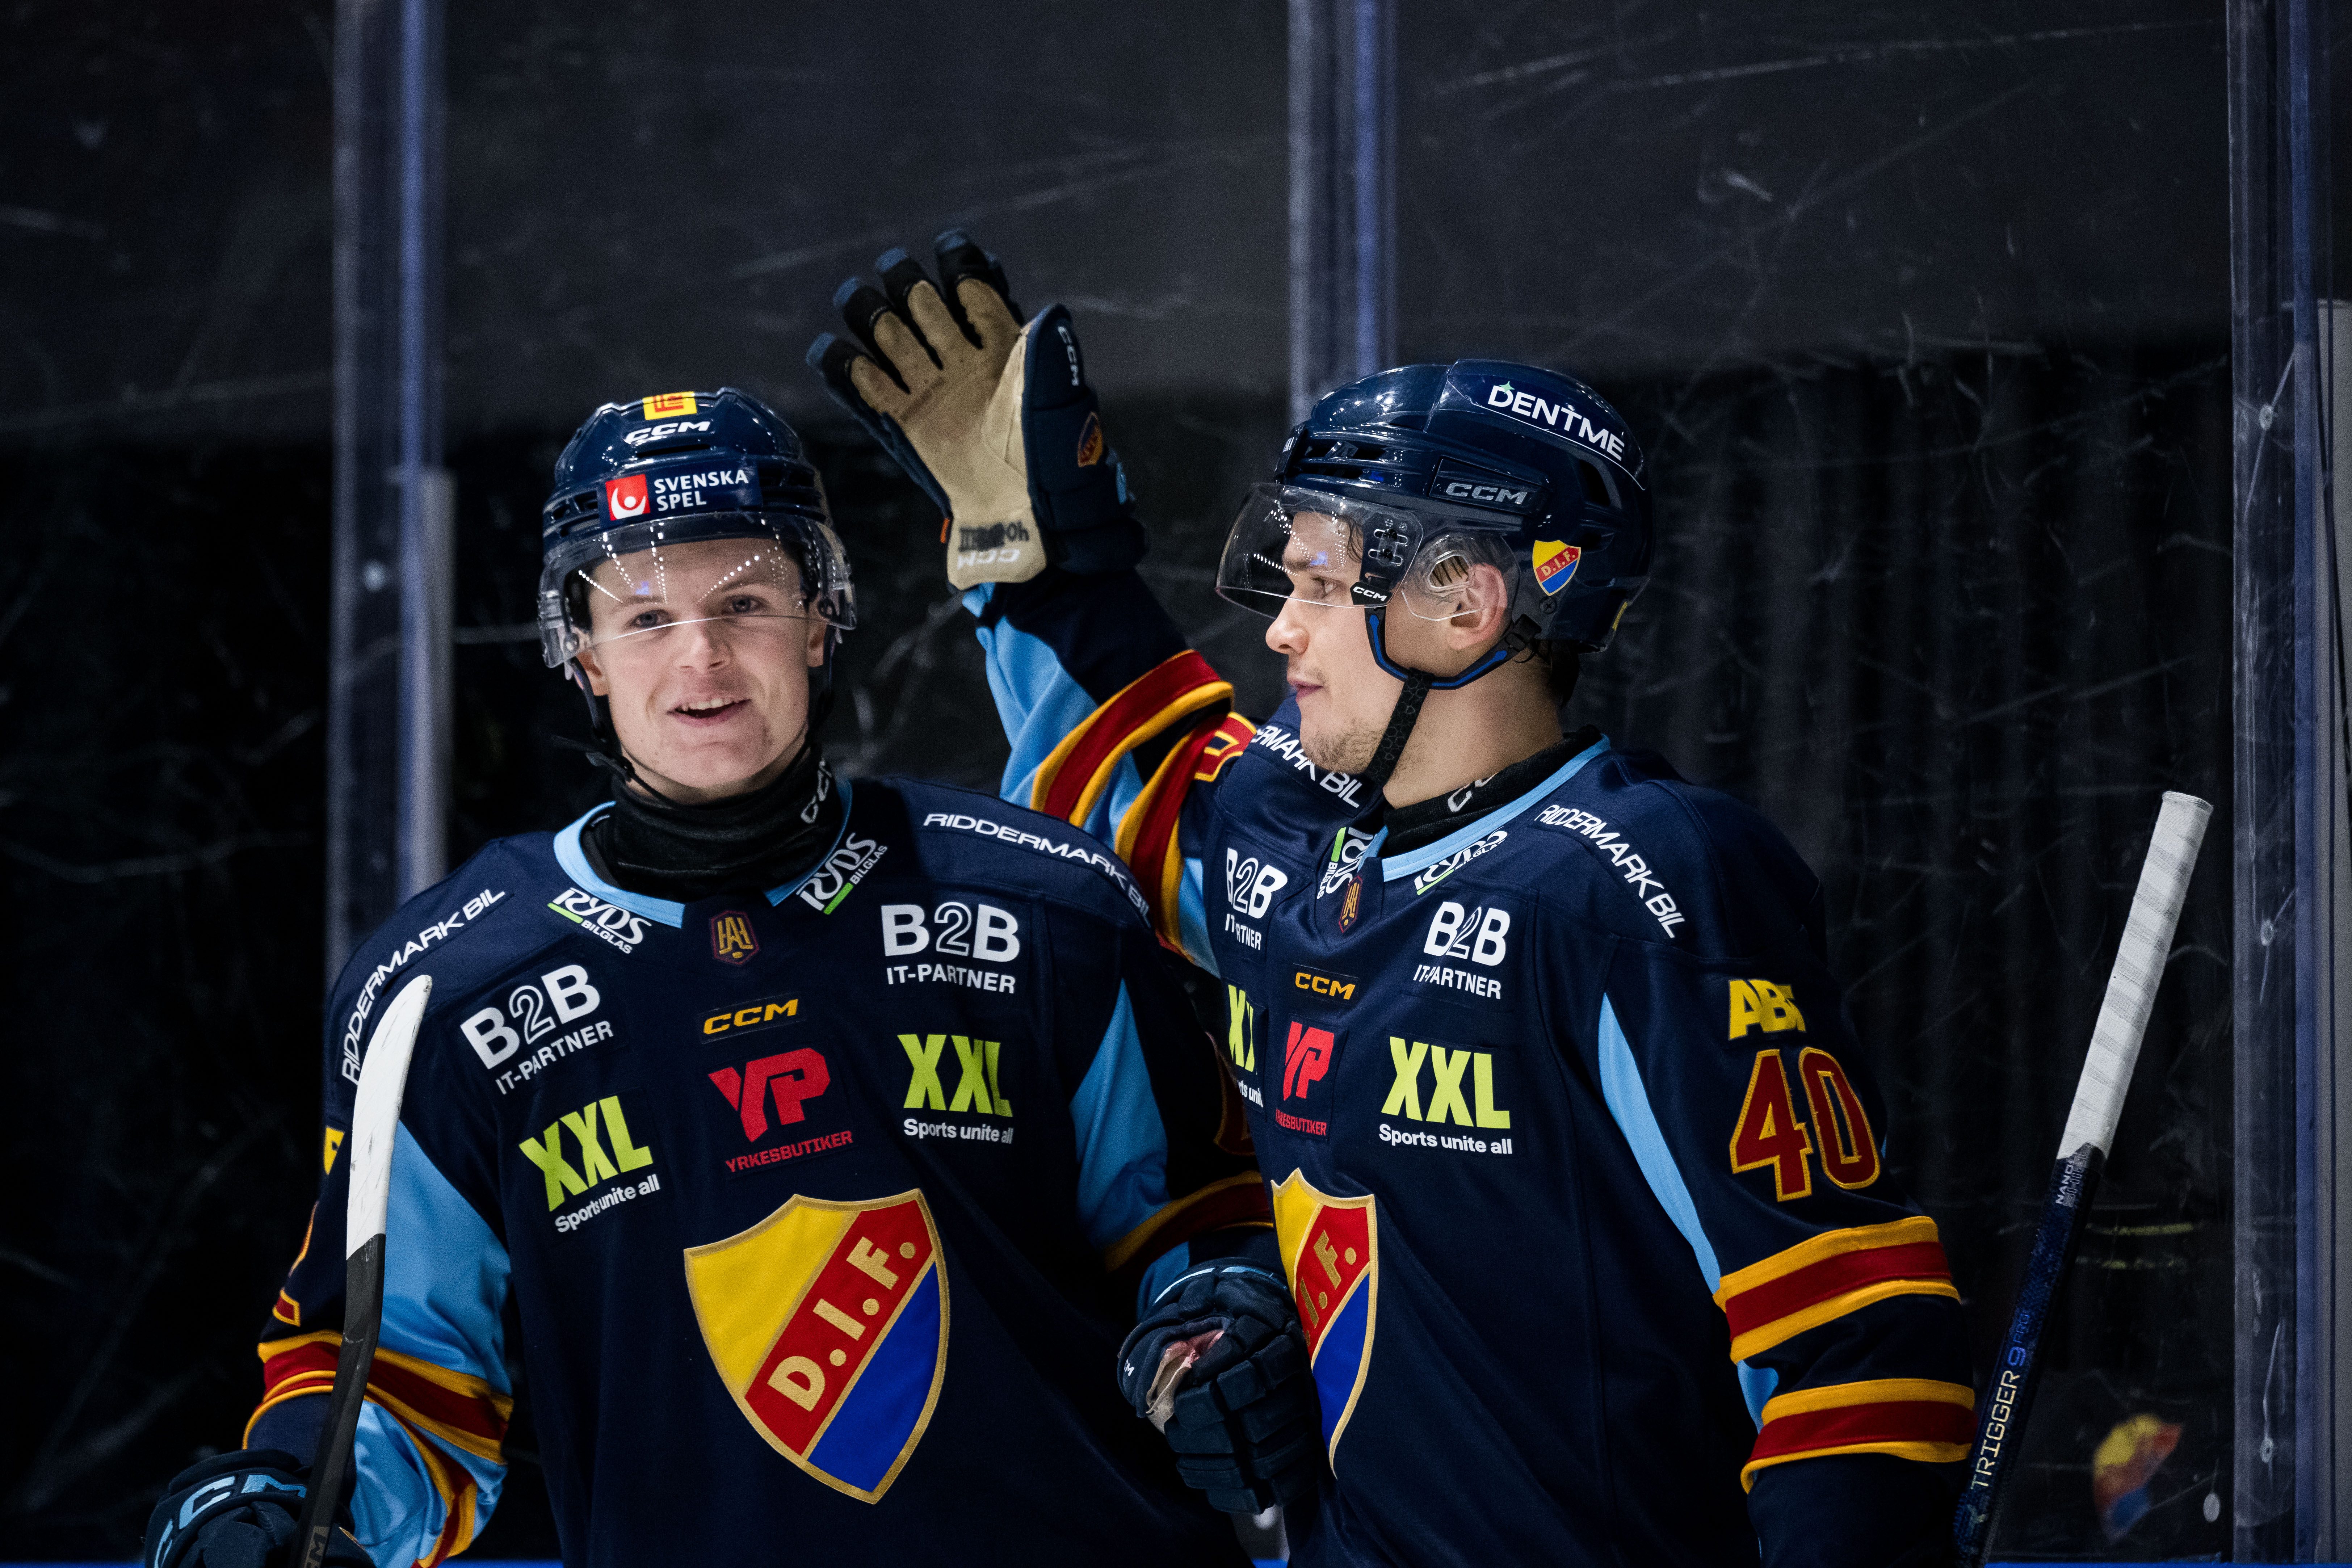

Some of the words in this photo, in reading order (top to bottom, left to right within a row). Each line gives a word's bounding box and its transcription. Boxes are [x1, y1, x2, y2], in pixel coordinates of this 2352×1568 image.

[624, 421, 711, 445] CCM
[1488, 384, 1625, 461] DENTME
[654, 470, 749, 494] SVENSKA
[656, 491, 707, 512] SPEL
[1445, 482, 1528, 504] CCM
[1353, 586, 1387, 601] CCM
[1540, 551, 1576, 578] D.I.F.
[1319, 772, 1362, 808] BIL
[849, 844, 888, 886] BILGLAS
[923, 813, 1126, 890] RIDDERMARK
[1534, 804, 1665, 899] RIDDERMARK
[1645, 893, 1685, 938] BIL
[1226, 847, 1288, 919] B2B
[553, 887, 652, 946] RYDS
[580, 918, 633, 954] BILGLAS
[881, 901, 1021, 962] B2B
[1423, 901, 1510, 966] B2B
[341, 911, 465, 1086] RIDDERMARK
[463, 888, 506, 921] BIL
[886, 964, 1016, 994] IT-PARTNER
[1295, 972, 1356, 1001] CCM
[460, 964, 601, 1070] B2B
[703, 999, 799, 1035] CCM
[496, 1021, 613, 1095] IT-PARTNER
[897, 1034, 1013, 1117] XXL
[1283, 1021, 1334, 1101] YP
[1381, 1037, 1511, 1129] XXL
[708, 1047, 831, 1143] YP
[1729, 1047, 1881, 1203] 40
[518, 1095, 653, 1212] XXL
[725, 1130, 854, 1173] YRKESBUTIKER
[903, 1118, 956, 1143] Sports
[960, 1121, 1000, 1141] unite
[1001, 1127, 1013, 1144] all
[1379, 1124, 1437, 1147] Sports
[1441, 1132, 1487, 1154] unite
[1490, 1138, 1512, 1155] all
[555, 1201, 600, 1233] Sports
[599, 1185, 637, 1213] unite
[638, 1175, 660, 1197] all
[767, 1236, 916, 1412] D.I.F.
[1971, 1370, 2020, 1490] TRIGGER
[2007, 1346, 2026, 1367] 9
